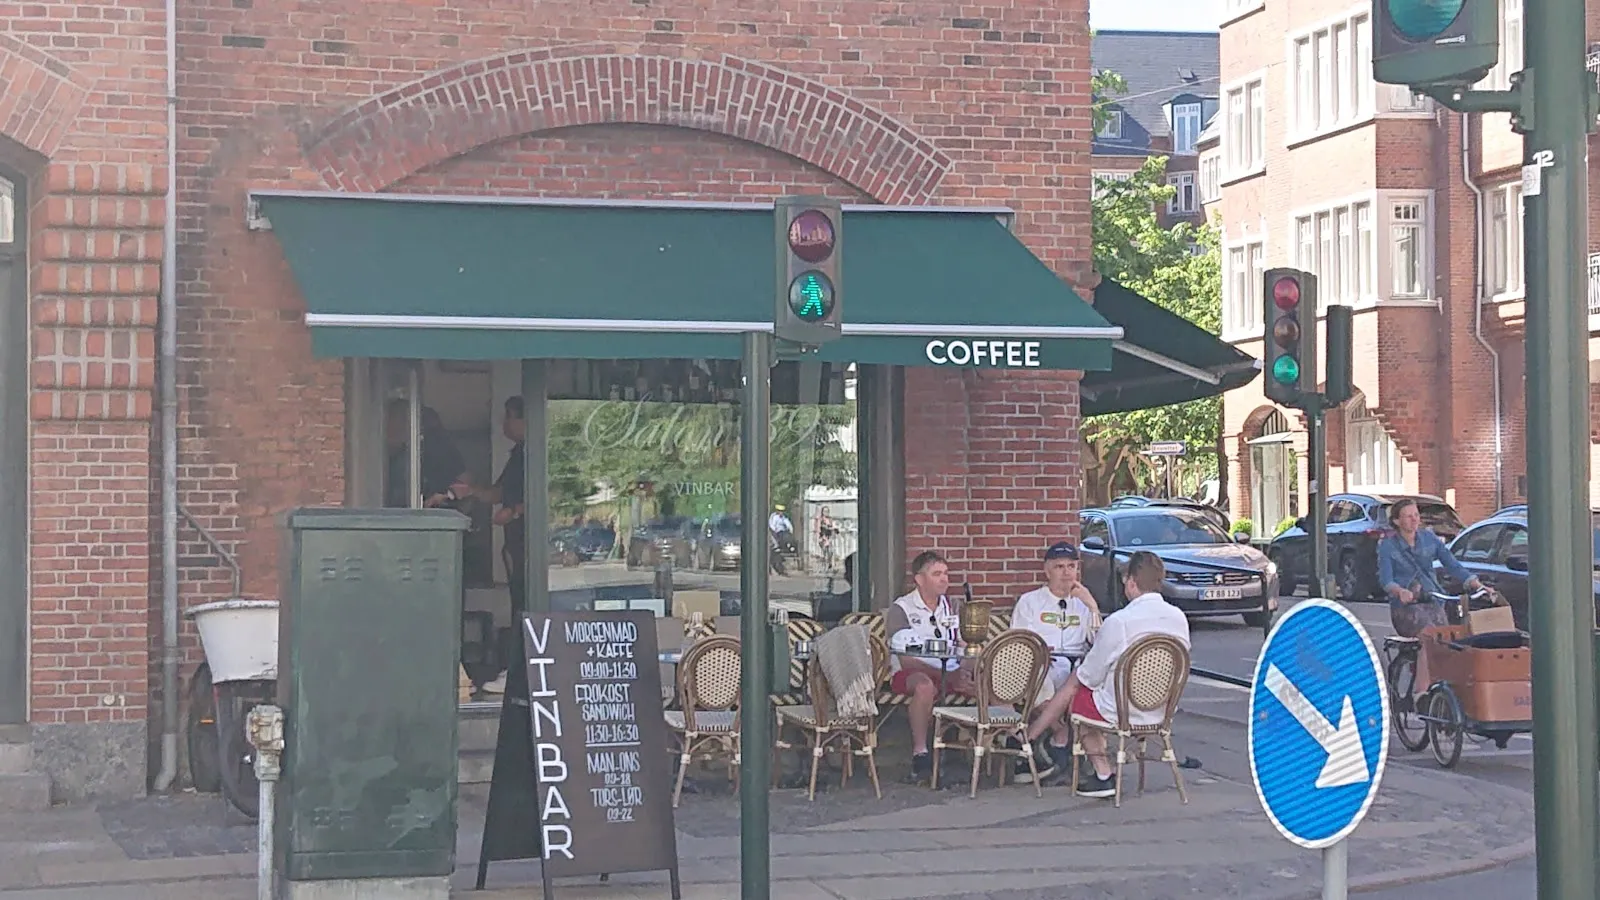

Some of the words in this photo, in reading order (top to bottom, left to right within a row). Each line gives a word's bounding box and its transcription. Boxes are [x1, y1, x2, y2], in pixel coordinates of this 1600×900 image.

[1532, 150, 1555, 167] 12
[925, 340, 1041, 367] COFFEE
[674, 481, 735, 497] VINBAR
[564, 621, 638, 643] MORGENMAD
[574, 683, 631, 704] FROKOST
[582, 703, 635, 722] SANDWICH
[524, 618, 575, 860] VINBAR
[587, 751, 641, 774] MAN-ONS
